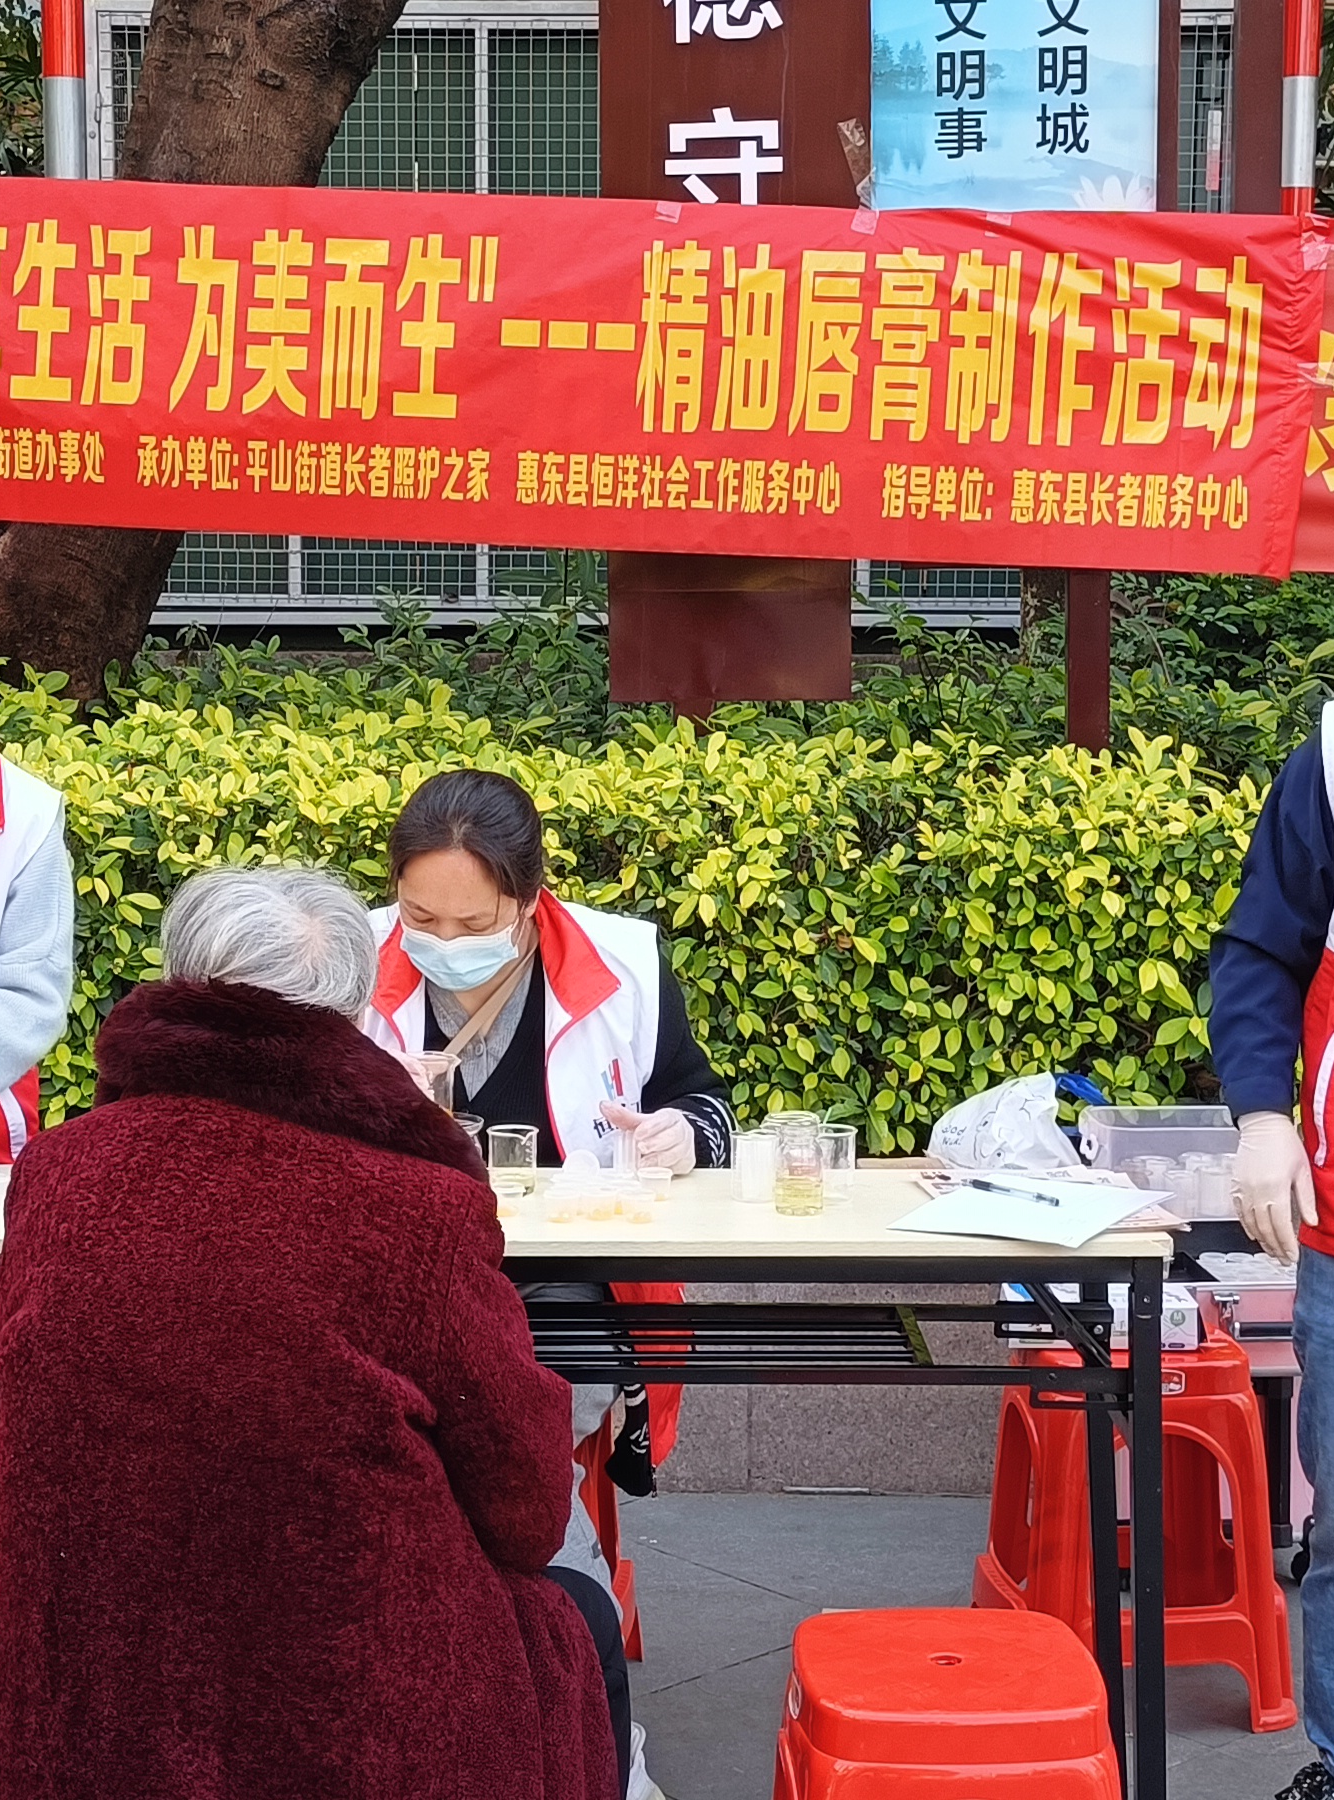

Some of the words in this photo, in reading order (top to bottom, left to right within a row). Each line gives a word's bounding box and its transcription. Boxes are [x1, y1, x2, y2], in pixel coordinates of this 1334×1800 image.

[515, 450, 842, 516] 惠东县恒洋社会工作服务中心
